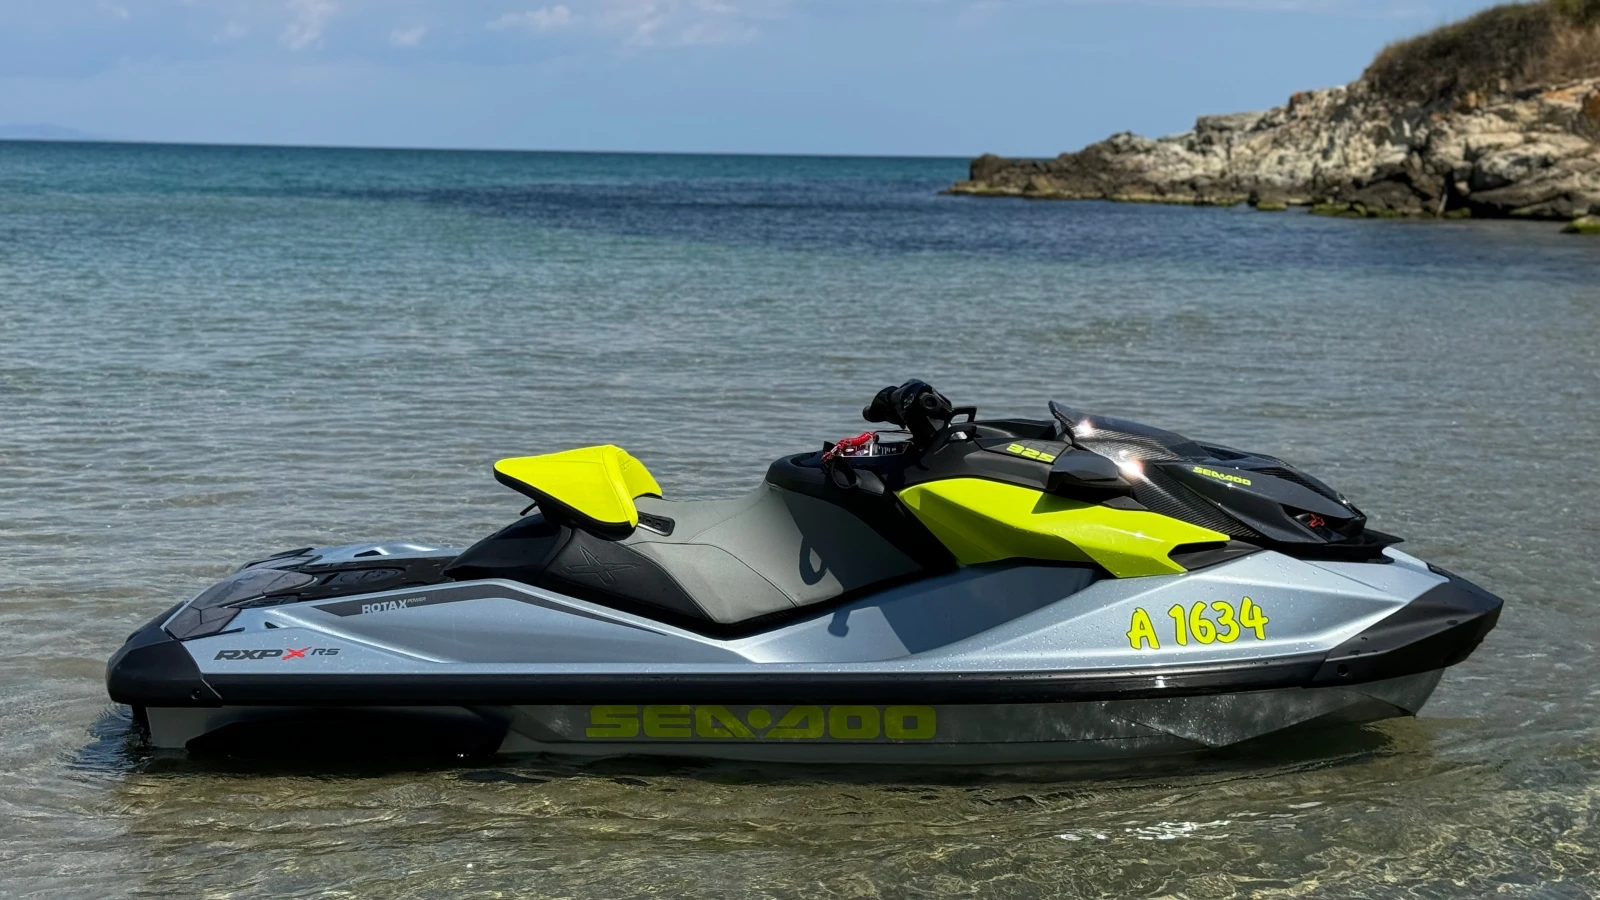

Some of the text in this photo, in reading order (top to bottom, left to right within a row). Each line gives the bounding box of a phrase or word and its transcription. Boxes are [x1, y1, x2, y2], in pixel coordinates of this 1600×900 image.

[1006, 443, 1056, 463] 325
[361, 599, 408, 615] ROTAX
[1126, 596, 1269, 649] A 1634
